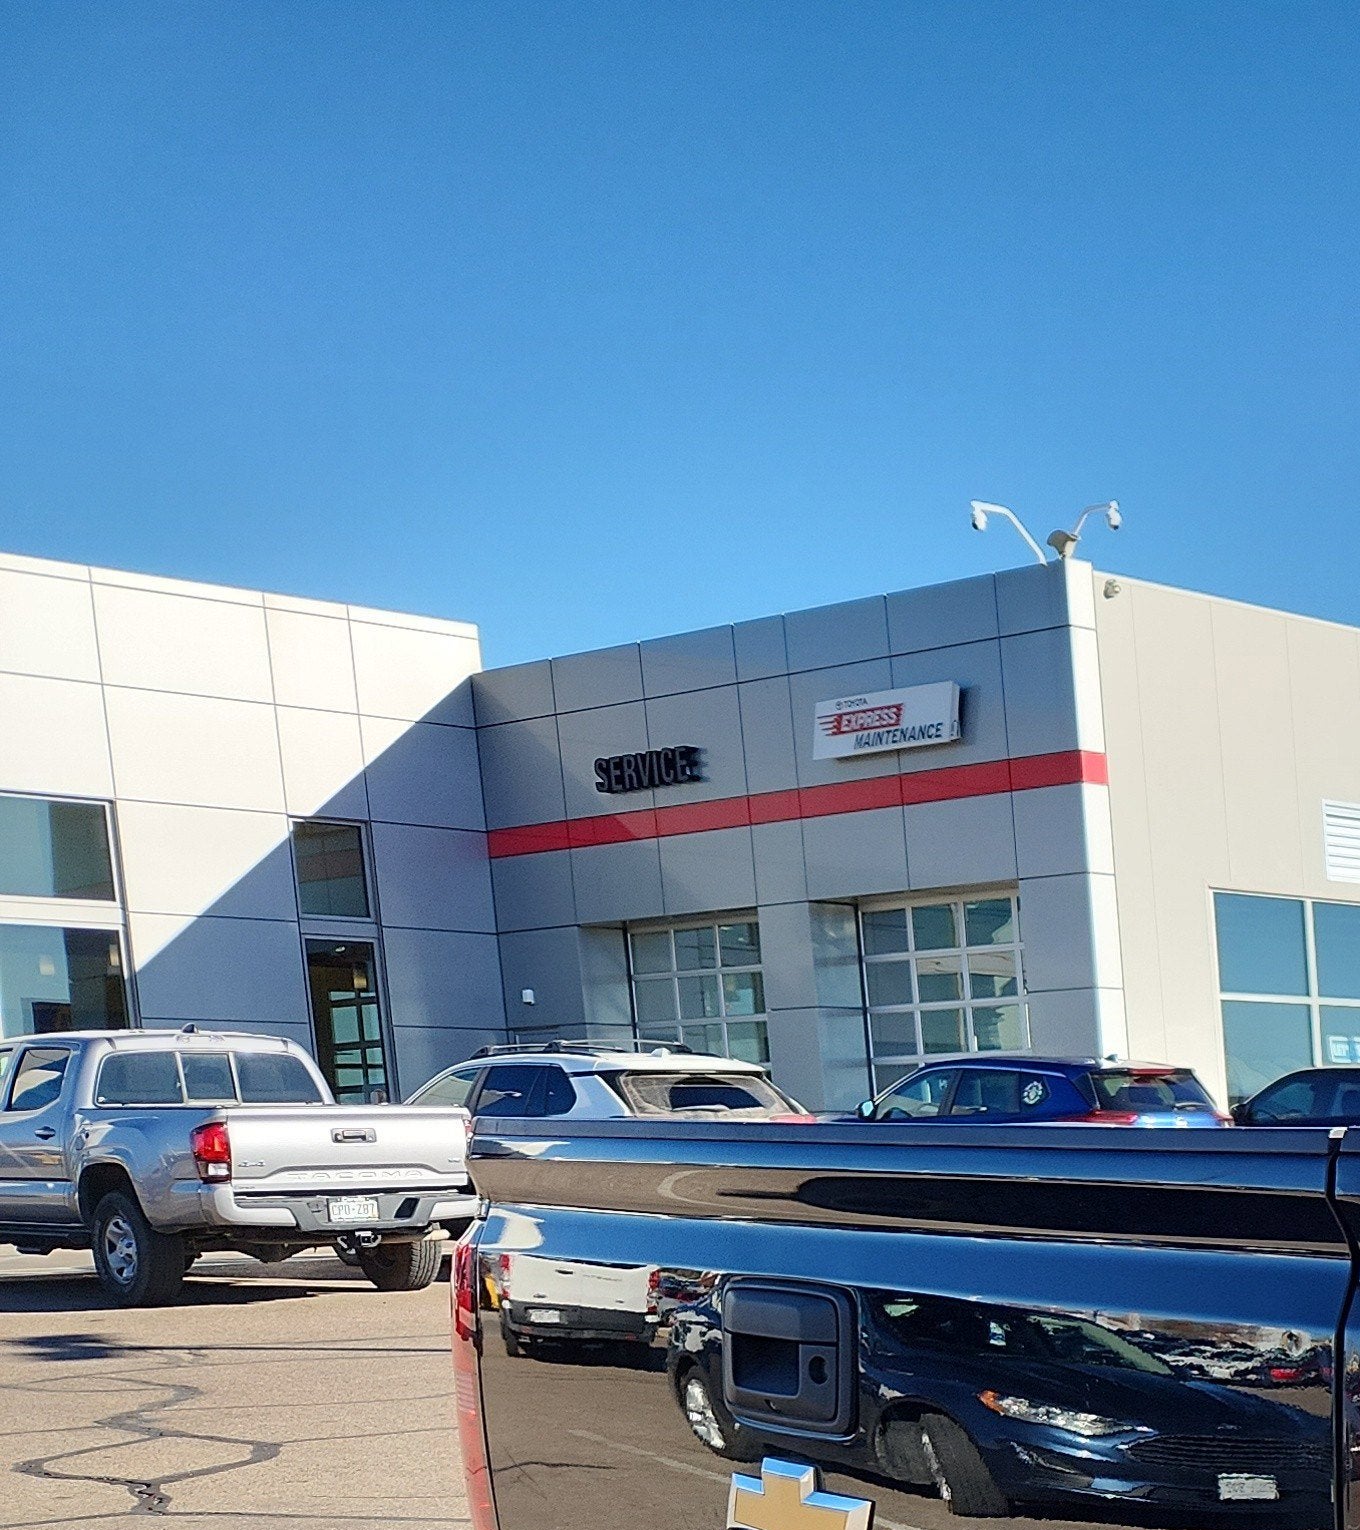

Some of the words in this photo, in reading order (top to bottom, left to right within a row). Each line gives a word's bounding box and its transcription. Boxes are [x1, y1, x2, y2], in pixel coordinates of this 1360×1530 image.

[841, 707, 899, 731] EXPRESS
[854, 722, 944, 750] MAINTENANCE
[594, 745, 696, 793] SERVICE
[286, 1169, 424, 1181] TACOMA
